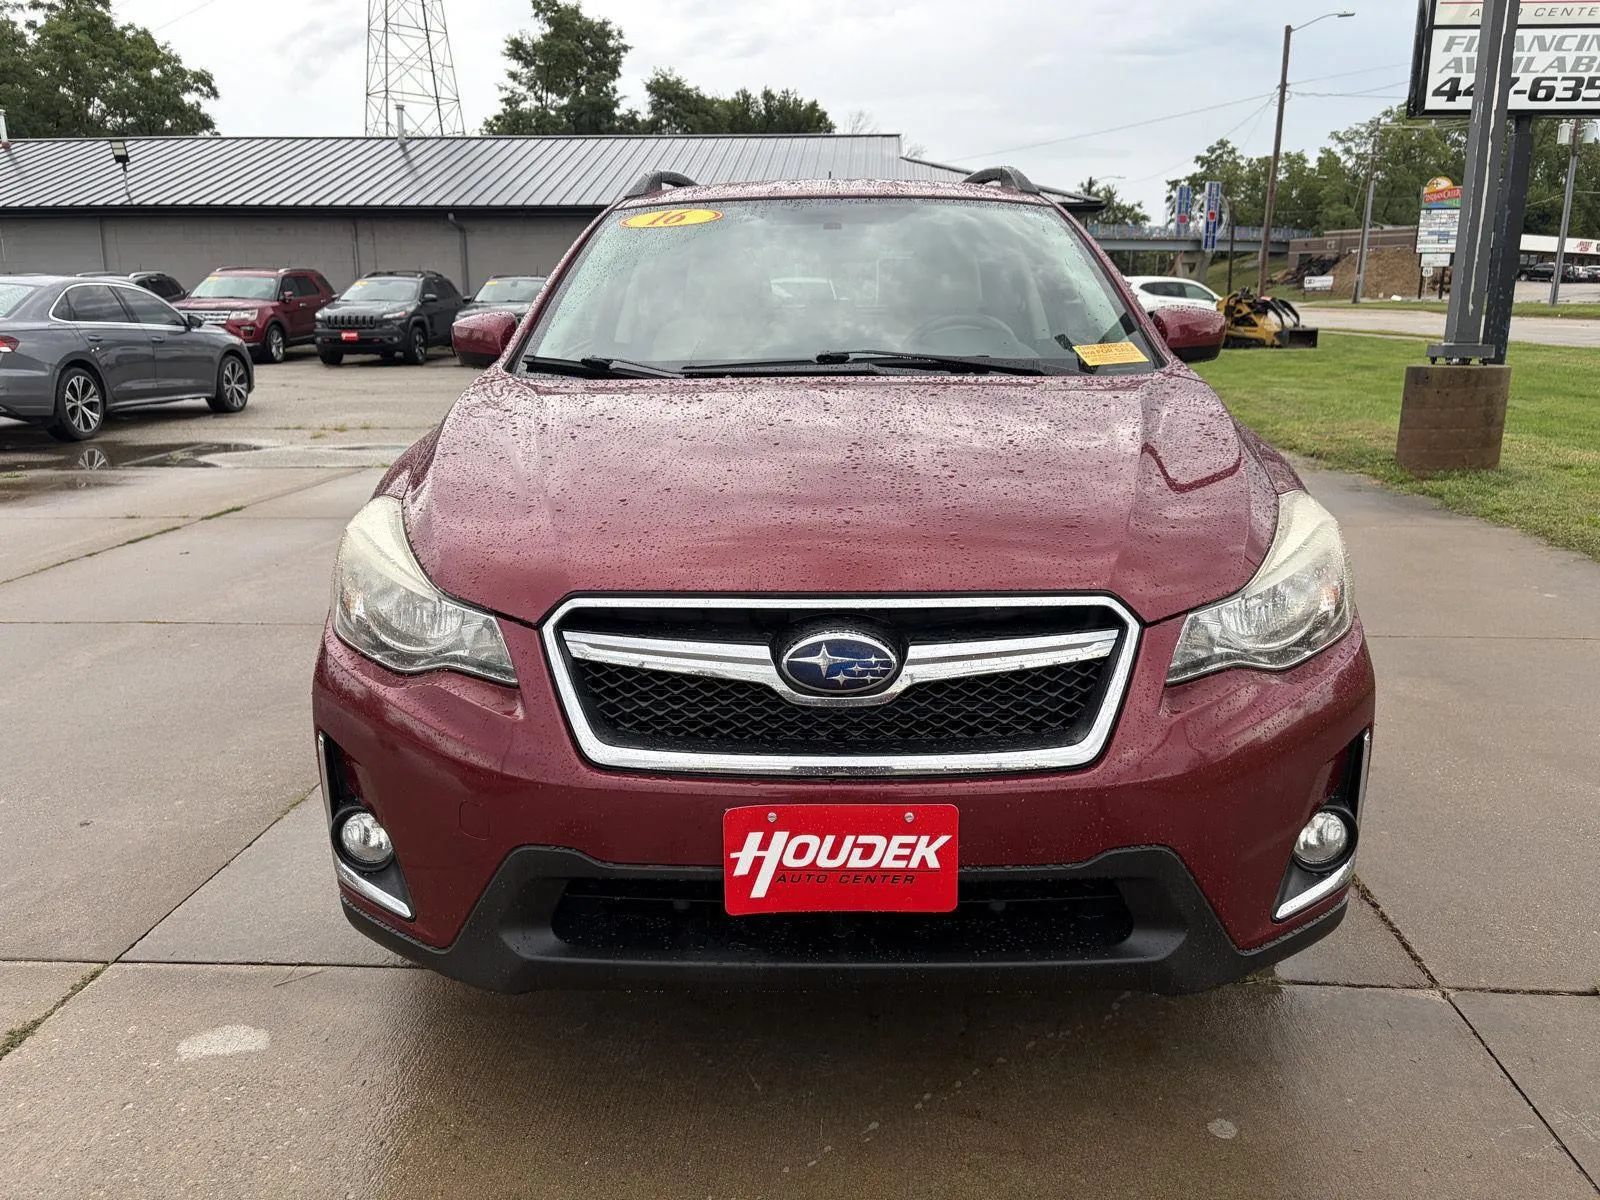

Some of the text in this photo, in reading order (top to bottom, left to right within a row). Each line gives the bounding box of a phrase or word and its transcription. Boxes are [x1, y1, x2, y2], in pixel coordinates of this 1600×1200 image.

[1534, 7, 1600, 17] CENTE
[1442, 35, 1600, 53] FINCI
[1437, 56, 1600, 74] AILAB
[647, 210, 692, 226] 16
[730, 831, 952, 898] HOUDEK
[776, 874, 916, 884] AUTO CENTER
